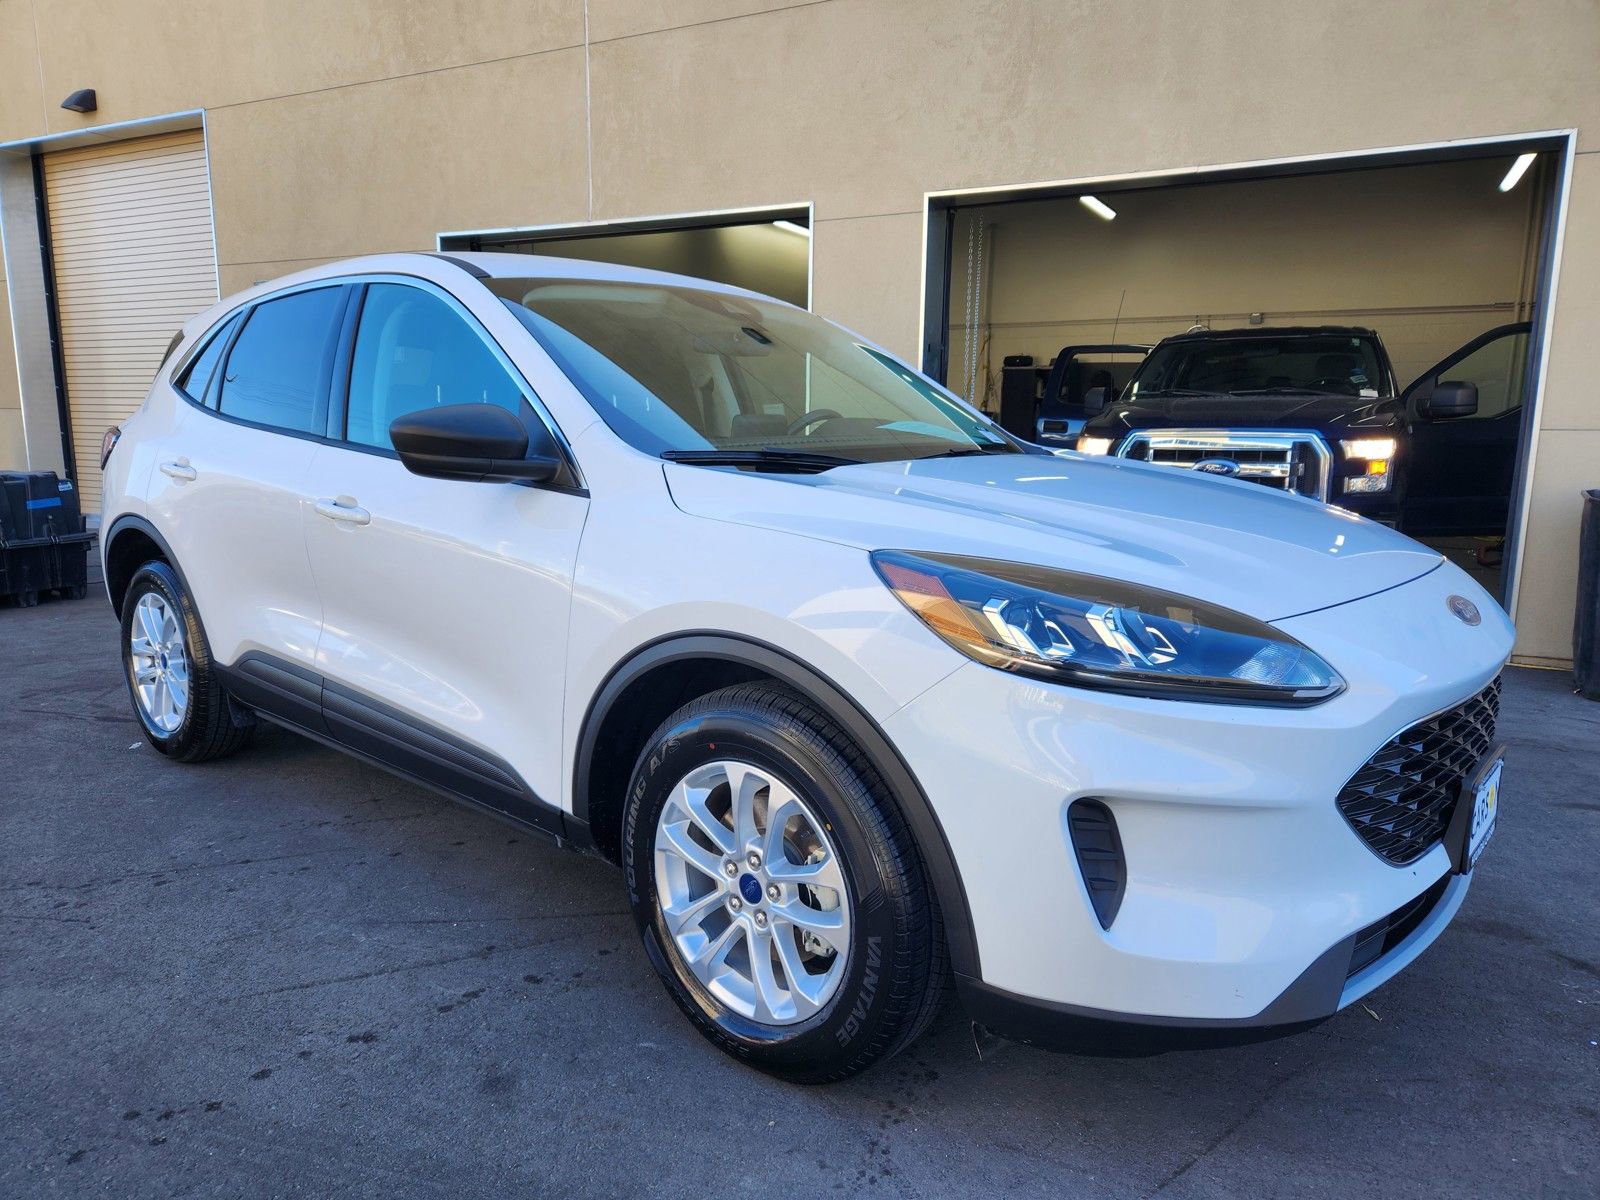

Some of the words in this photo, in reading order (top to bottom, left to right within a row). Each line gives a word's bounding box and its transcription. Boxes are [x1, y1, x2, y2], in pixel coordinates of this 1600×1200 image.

[625, 776, 647, 906] TOURING
[650, 737, 681, 776] A/S
[835, 936, 882, 1049] VANTAGE
